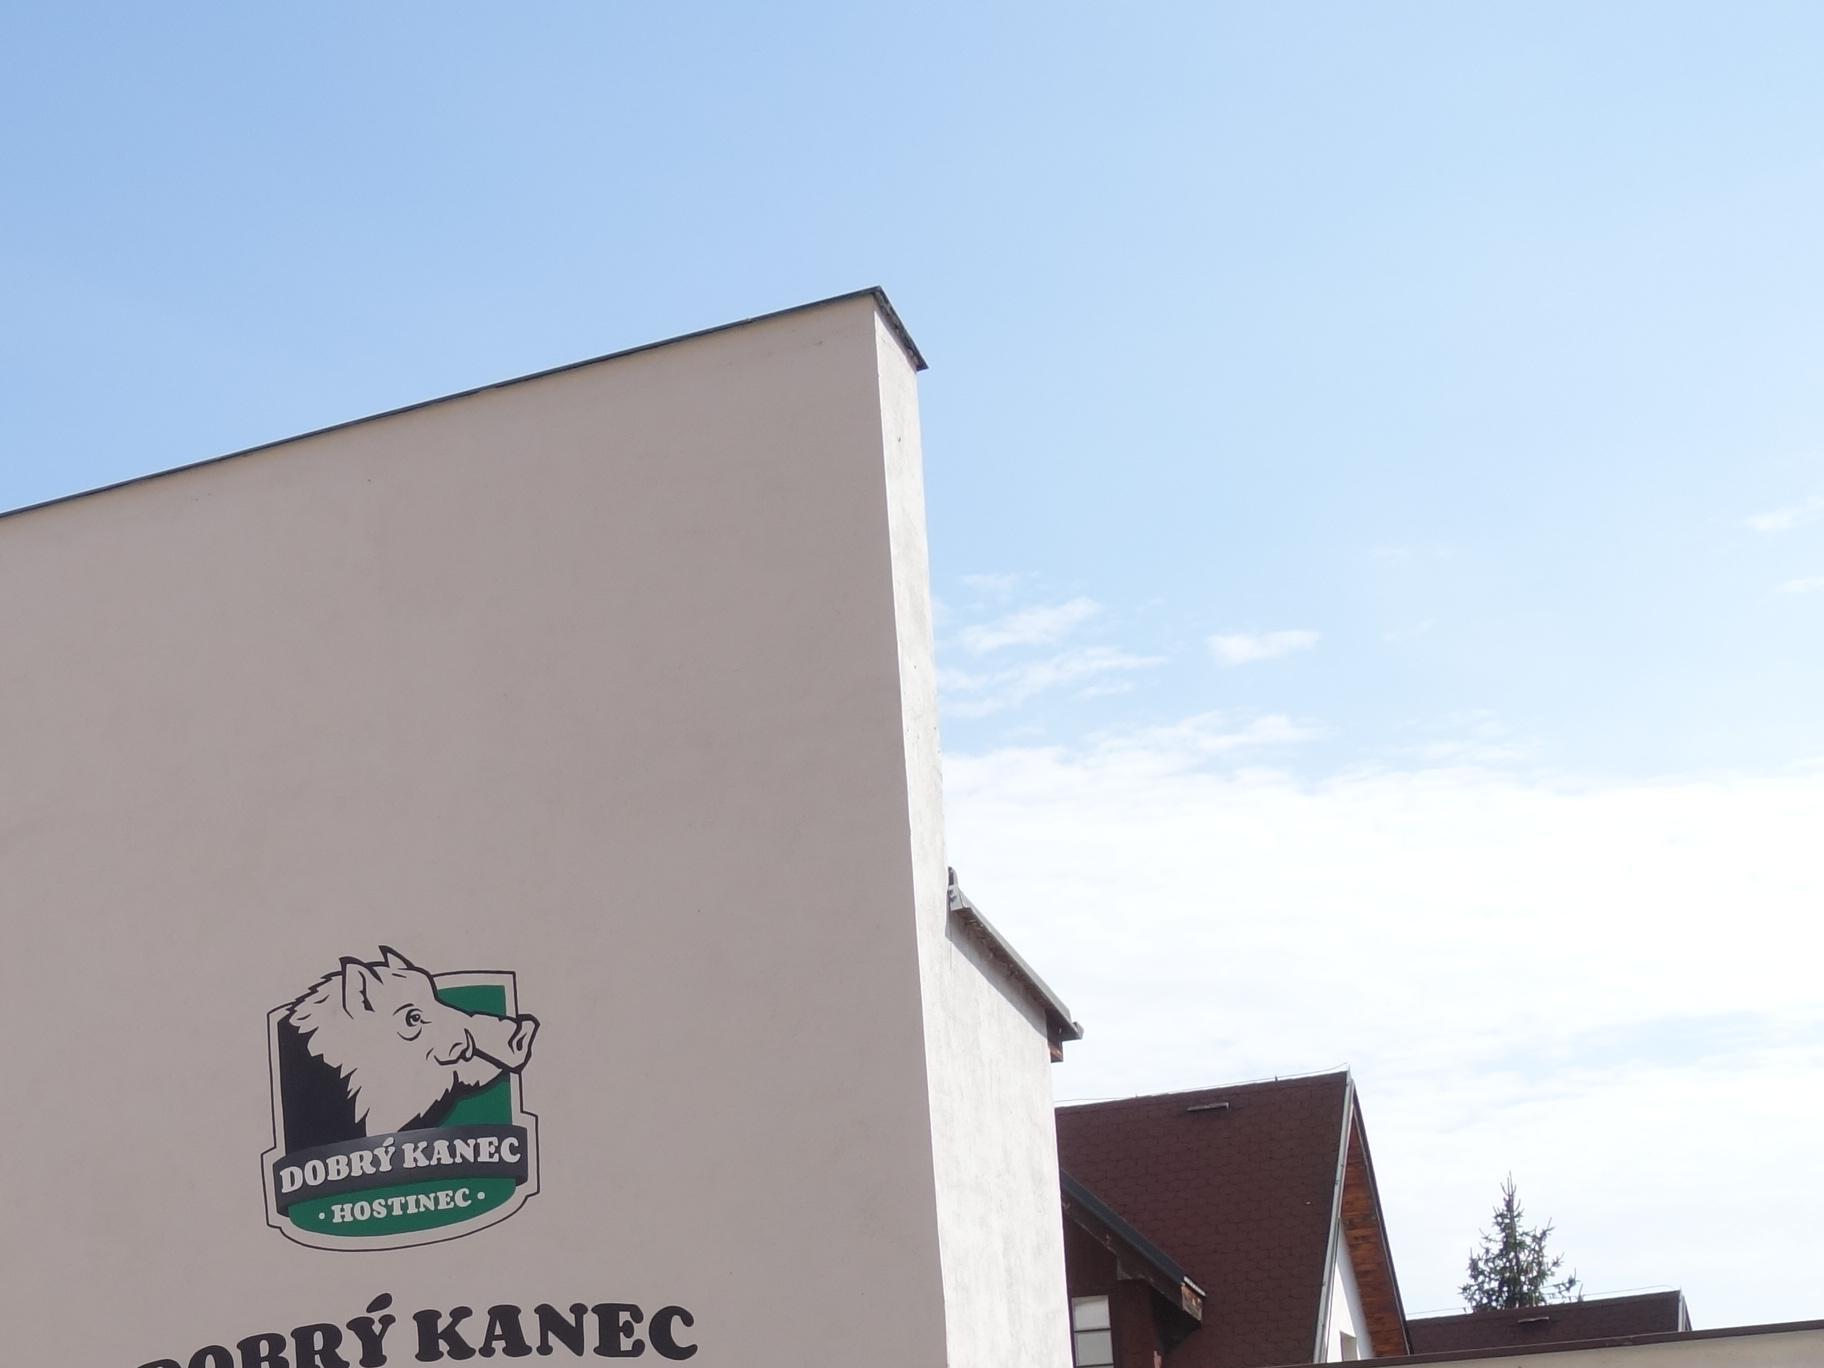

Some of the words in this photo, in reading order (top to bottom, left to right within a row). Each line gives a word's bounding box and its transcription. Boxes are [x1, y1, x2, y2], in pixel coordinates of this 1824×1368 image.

[279, 1137, 396, 1193] DOBRÝ
[401, 1136, 521, 1169] KANEC
[331, 1188, 472, 1223] HOSTINEC
[413, 1302, 698, 1362] KANEC
